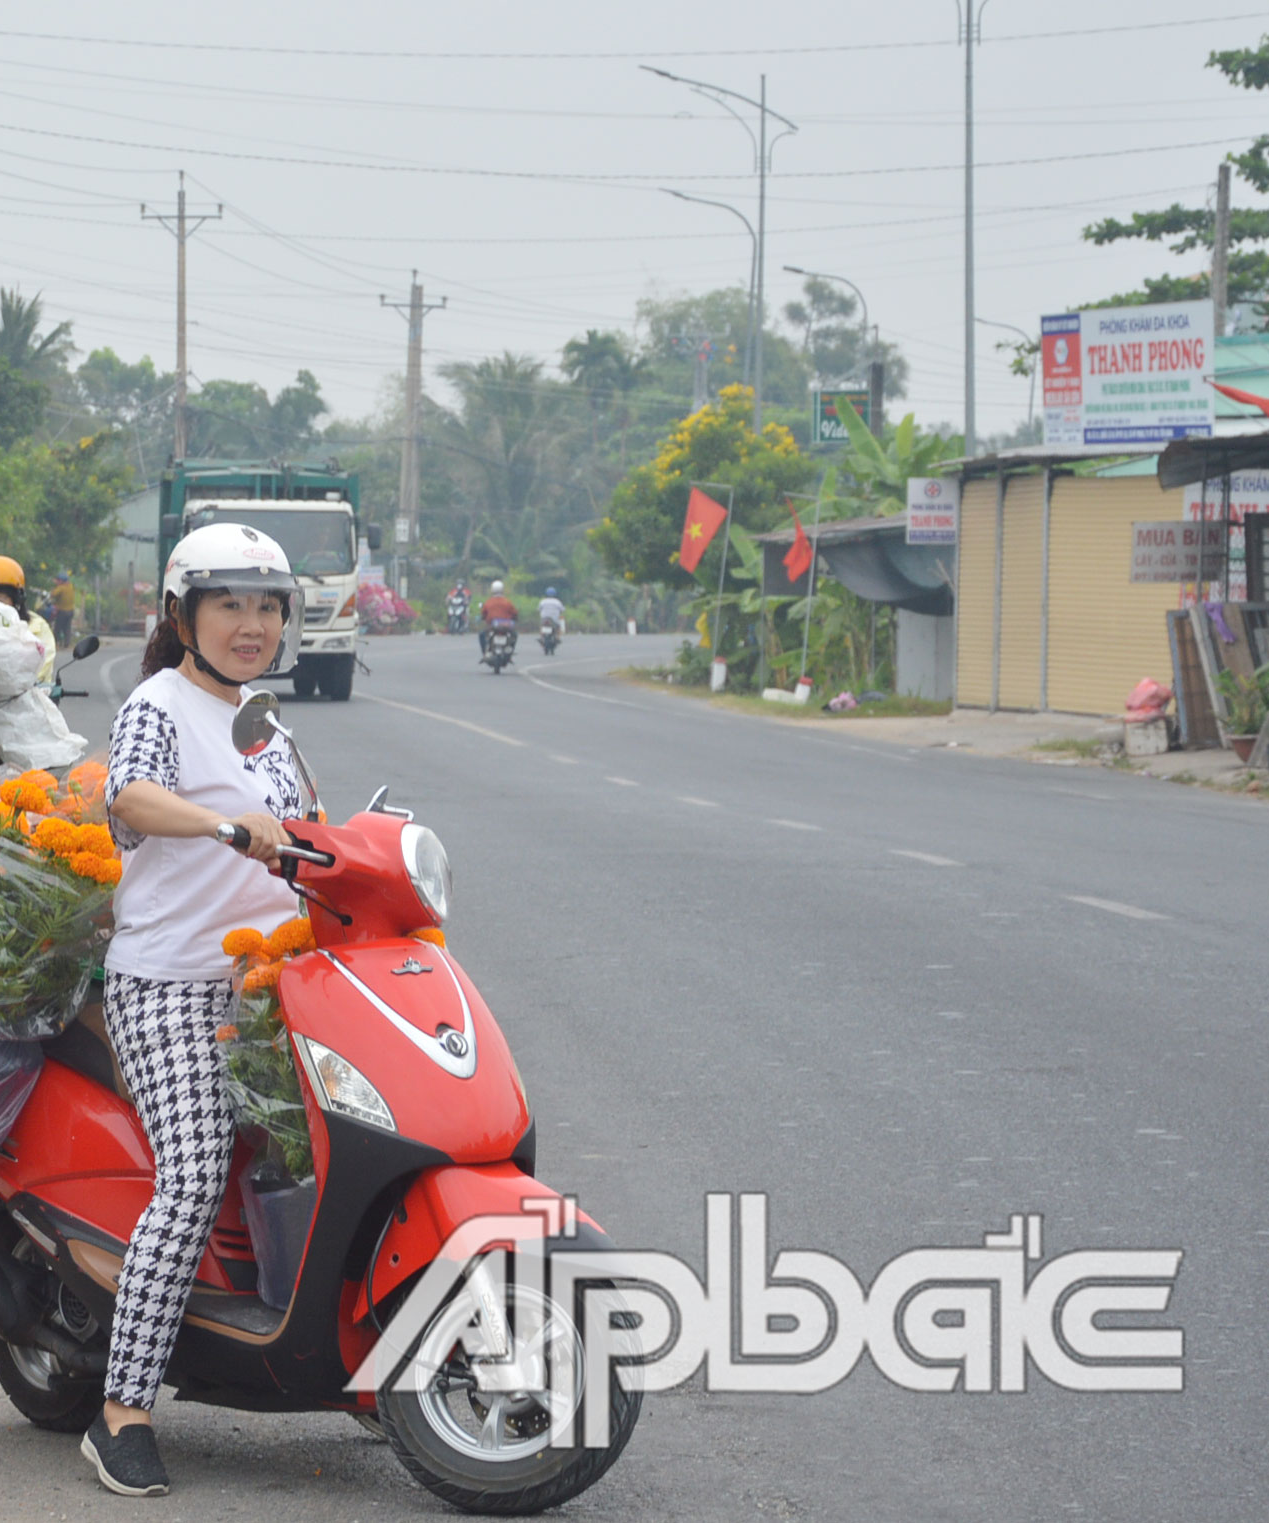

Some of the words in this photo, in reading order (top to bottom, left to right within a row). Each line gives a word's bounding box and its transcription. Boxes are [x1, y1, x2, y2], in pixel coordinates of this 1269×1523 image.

[1087, 341, 1143, 375] THANH
[1148, 337, 1205, 372] PHONG
[1136, 528, 1176, 547] MUA
